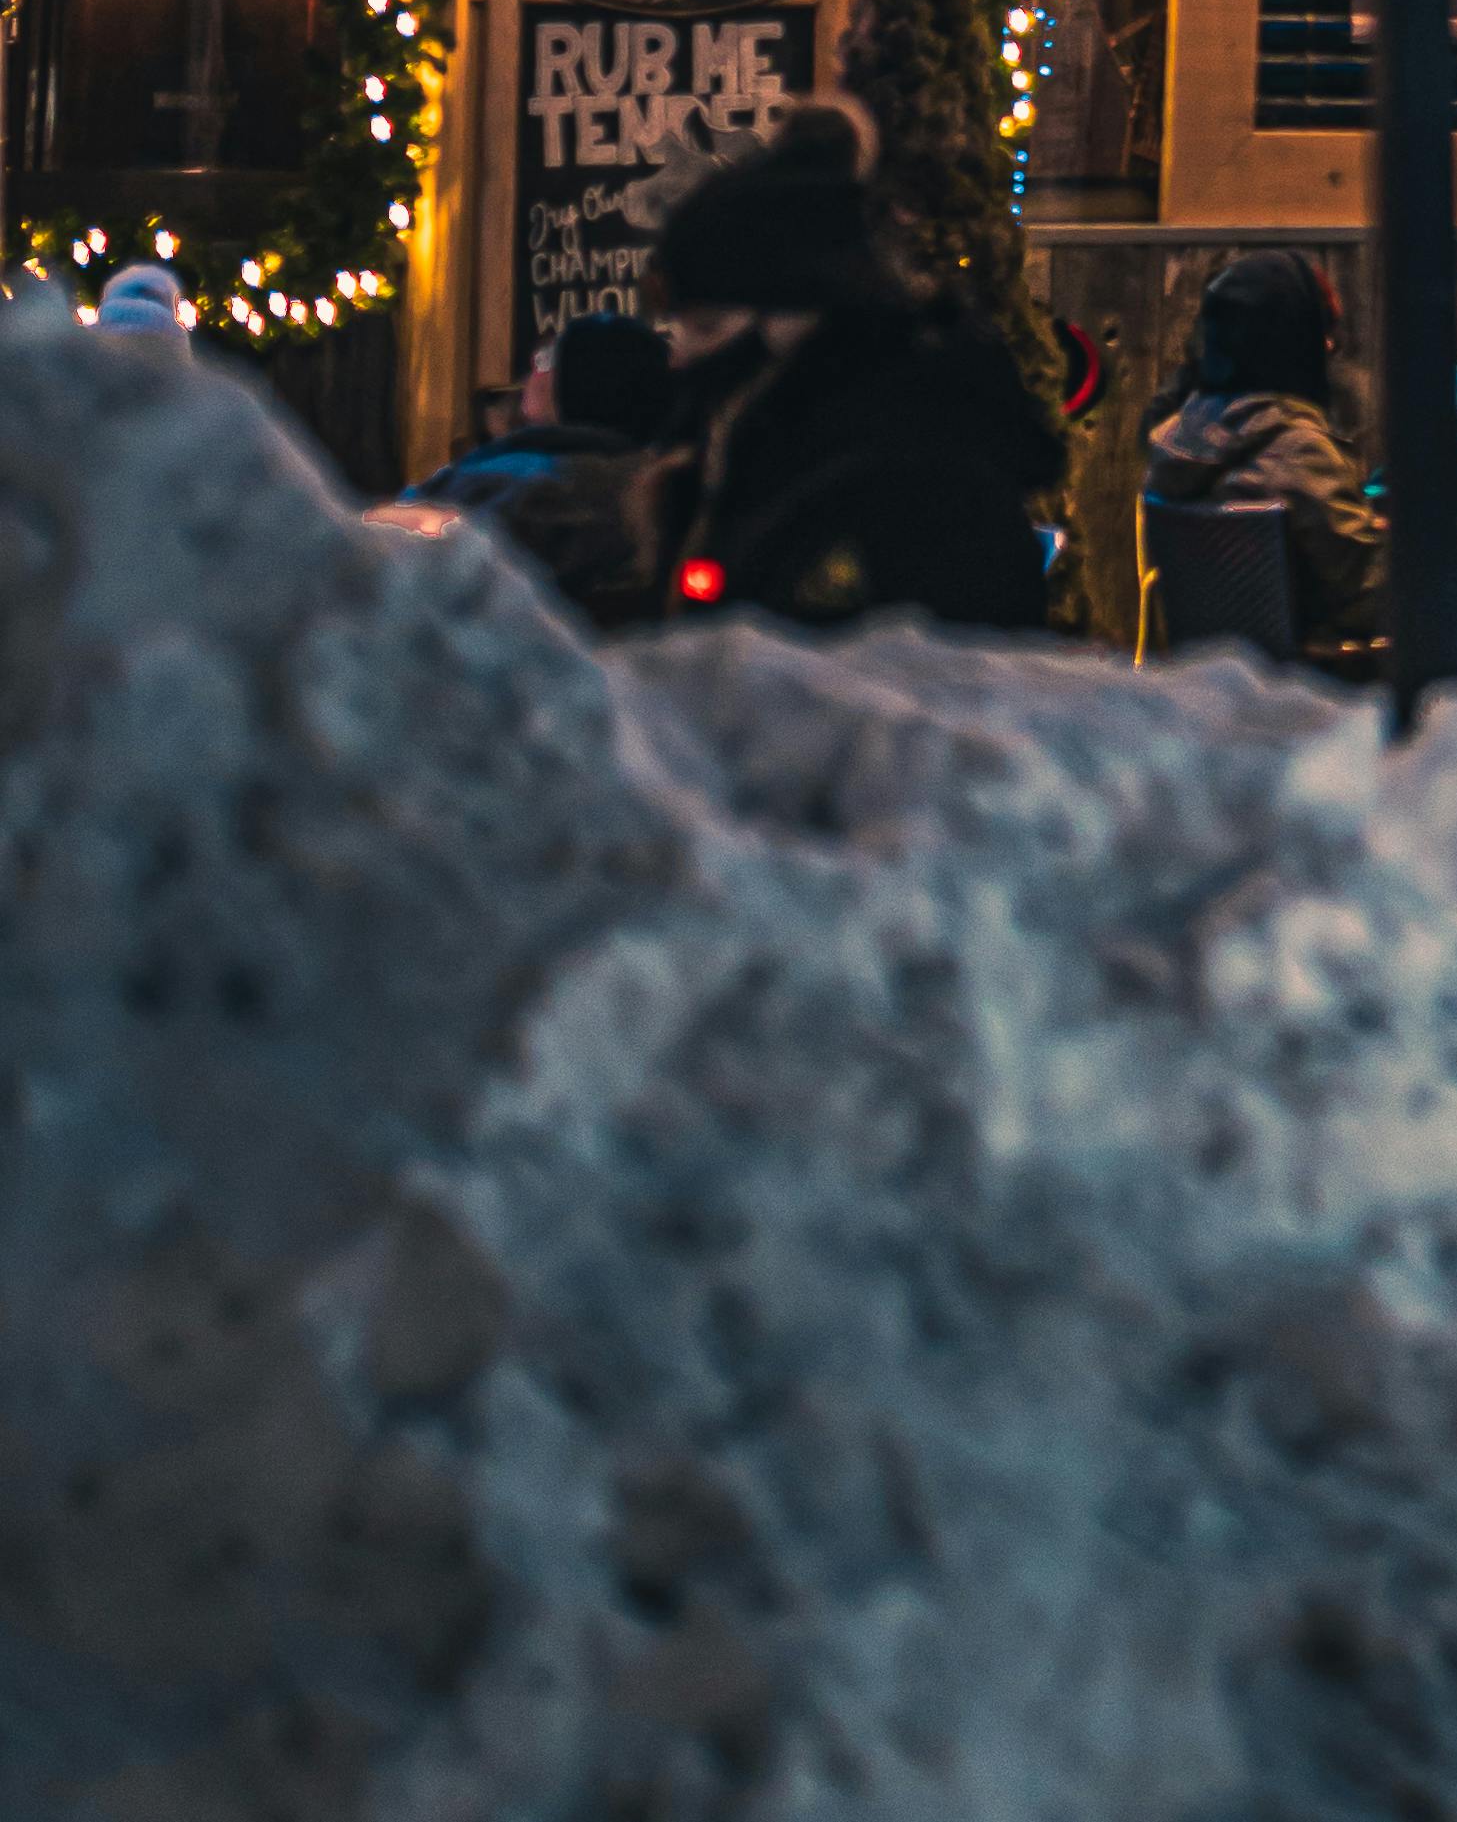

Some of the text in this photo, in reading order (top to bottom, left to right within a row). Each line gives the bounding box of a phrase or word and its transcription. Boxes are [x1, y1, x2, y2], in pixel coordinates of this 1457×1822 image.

[534, 21, 786, 96] RUB ME
[528, 94, 795, 168] TEN
[530, 246, 656, 287] CHAMPI
